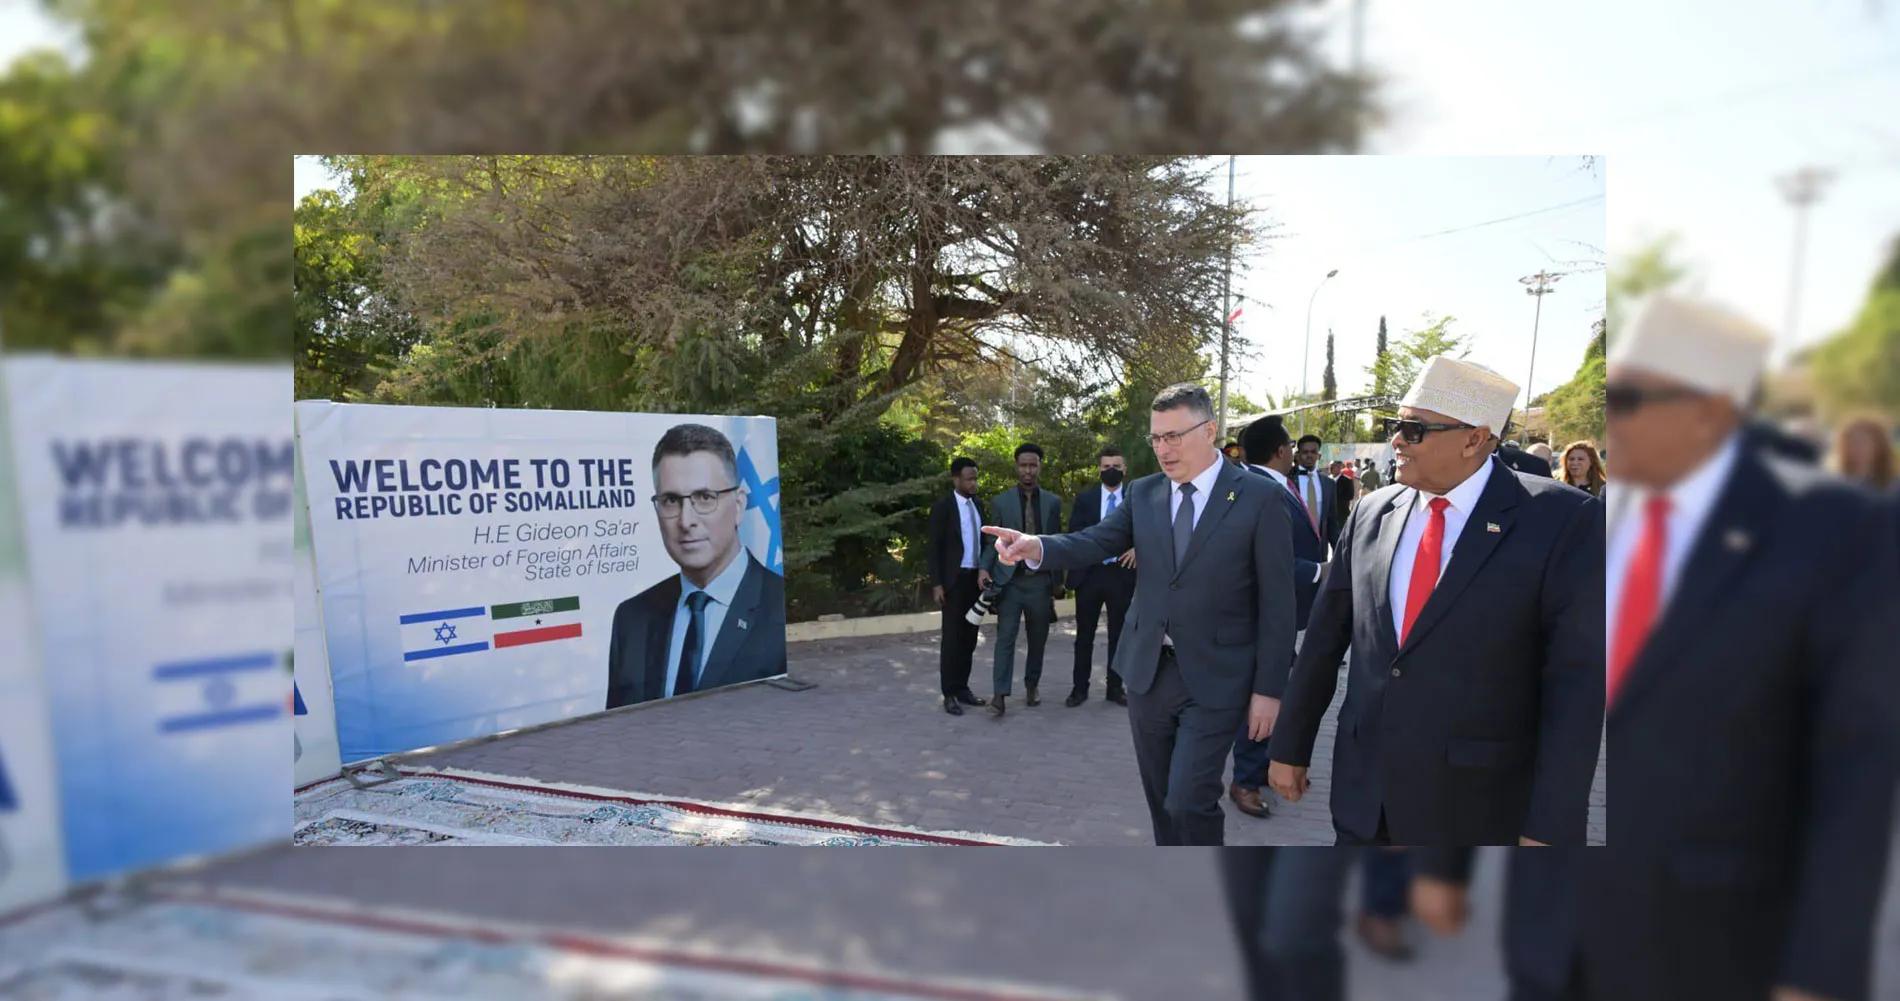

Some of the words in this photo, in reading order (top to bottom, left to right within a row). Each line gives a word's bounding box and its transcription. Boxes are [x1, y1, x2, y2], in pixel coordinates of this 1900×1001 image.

[329, 458, 522, 493] WELCOME
[529, 458, 571, 489] TO
[578, 458, 634, 488] THE
[335, 493, 463, 520] REPUBLIC
[469, 492, 498, 514] OF
[504, 488, 636, 513] SOMALILAND
[473, 524, 511, 545] H.E
[516, 522, 589, 542] Gideon
[594, 518, 640, 538] Sa'ar
[407, 554, 488, 574] Minister
[492, 549, 513, 568] of
[516, 547, 582, 566] Foreign
[586, 542, 638, 560] Affairs
[525, 563, 572, 581] State
[576, 559, 595, 577] of
[597, 556, 639, 575] Israel
